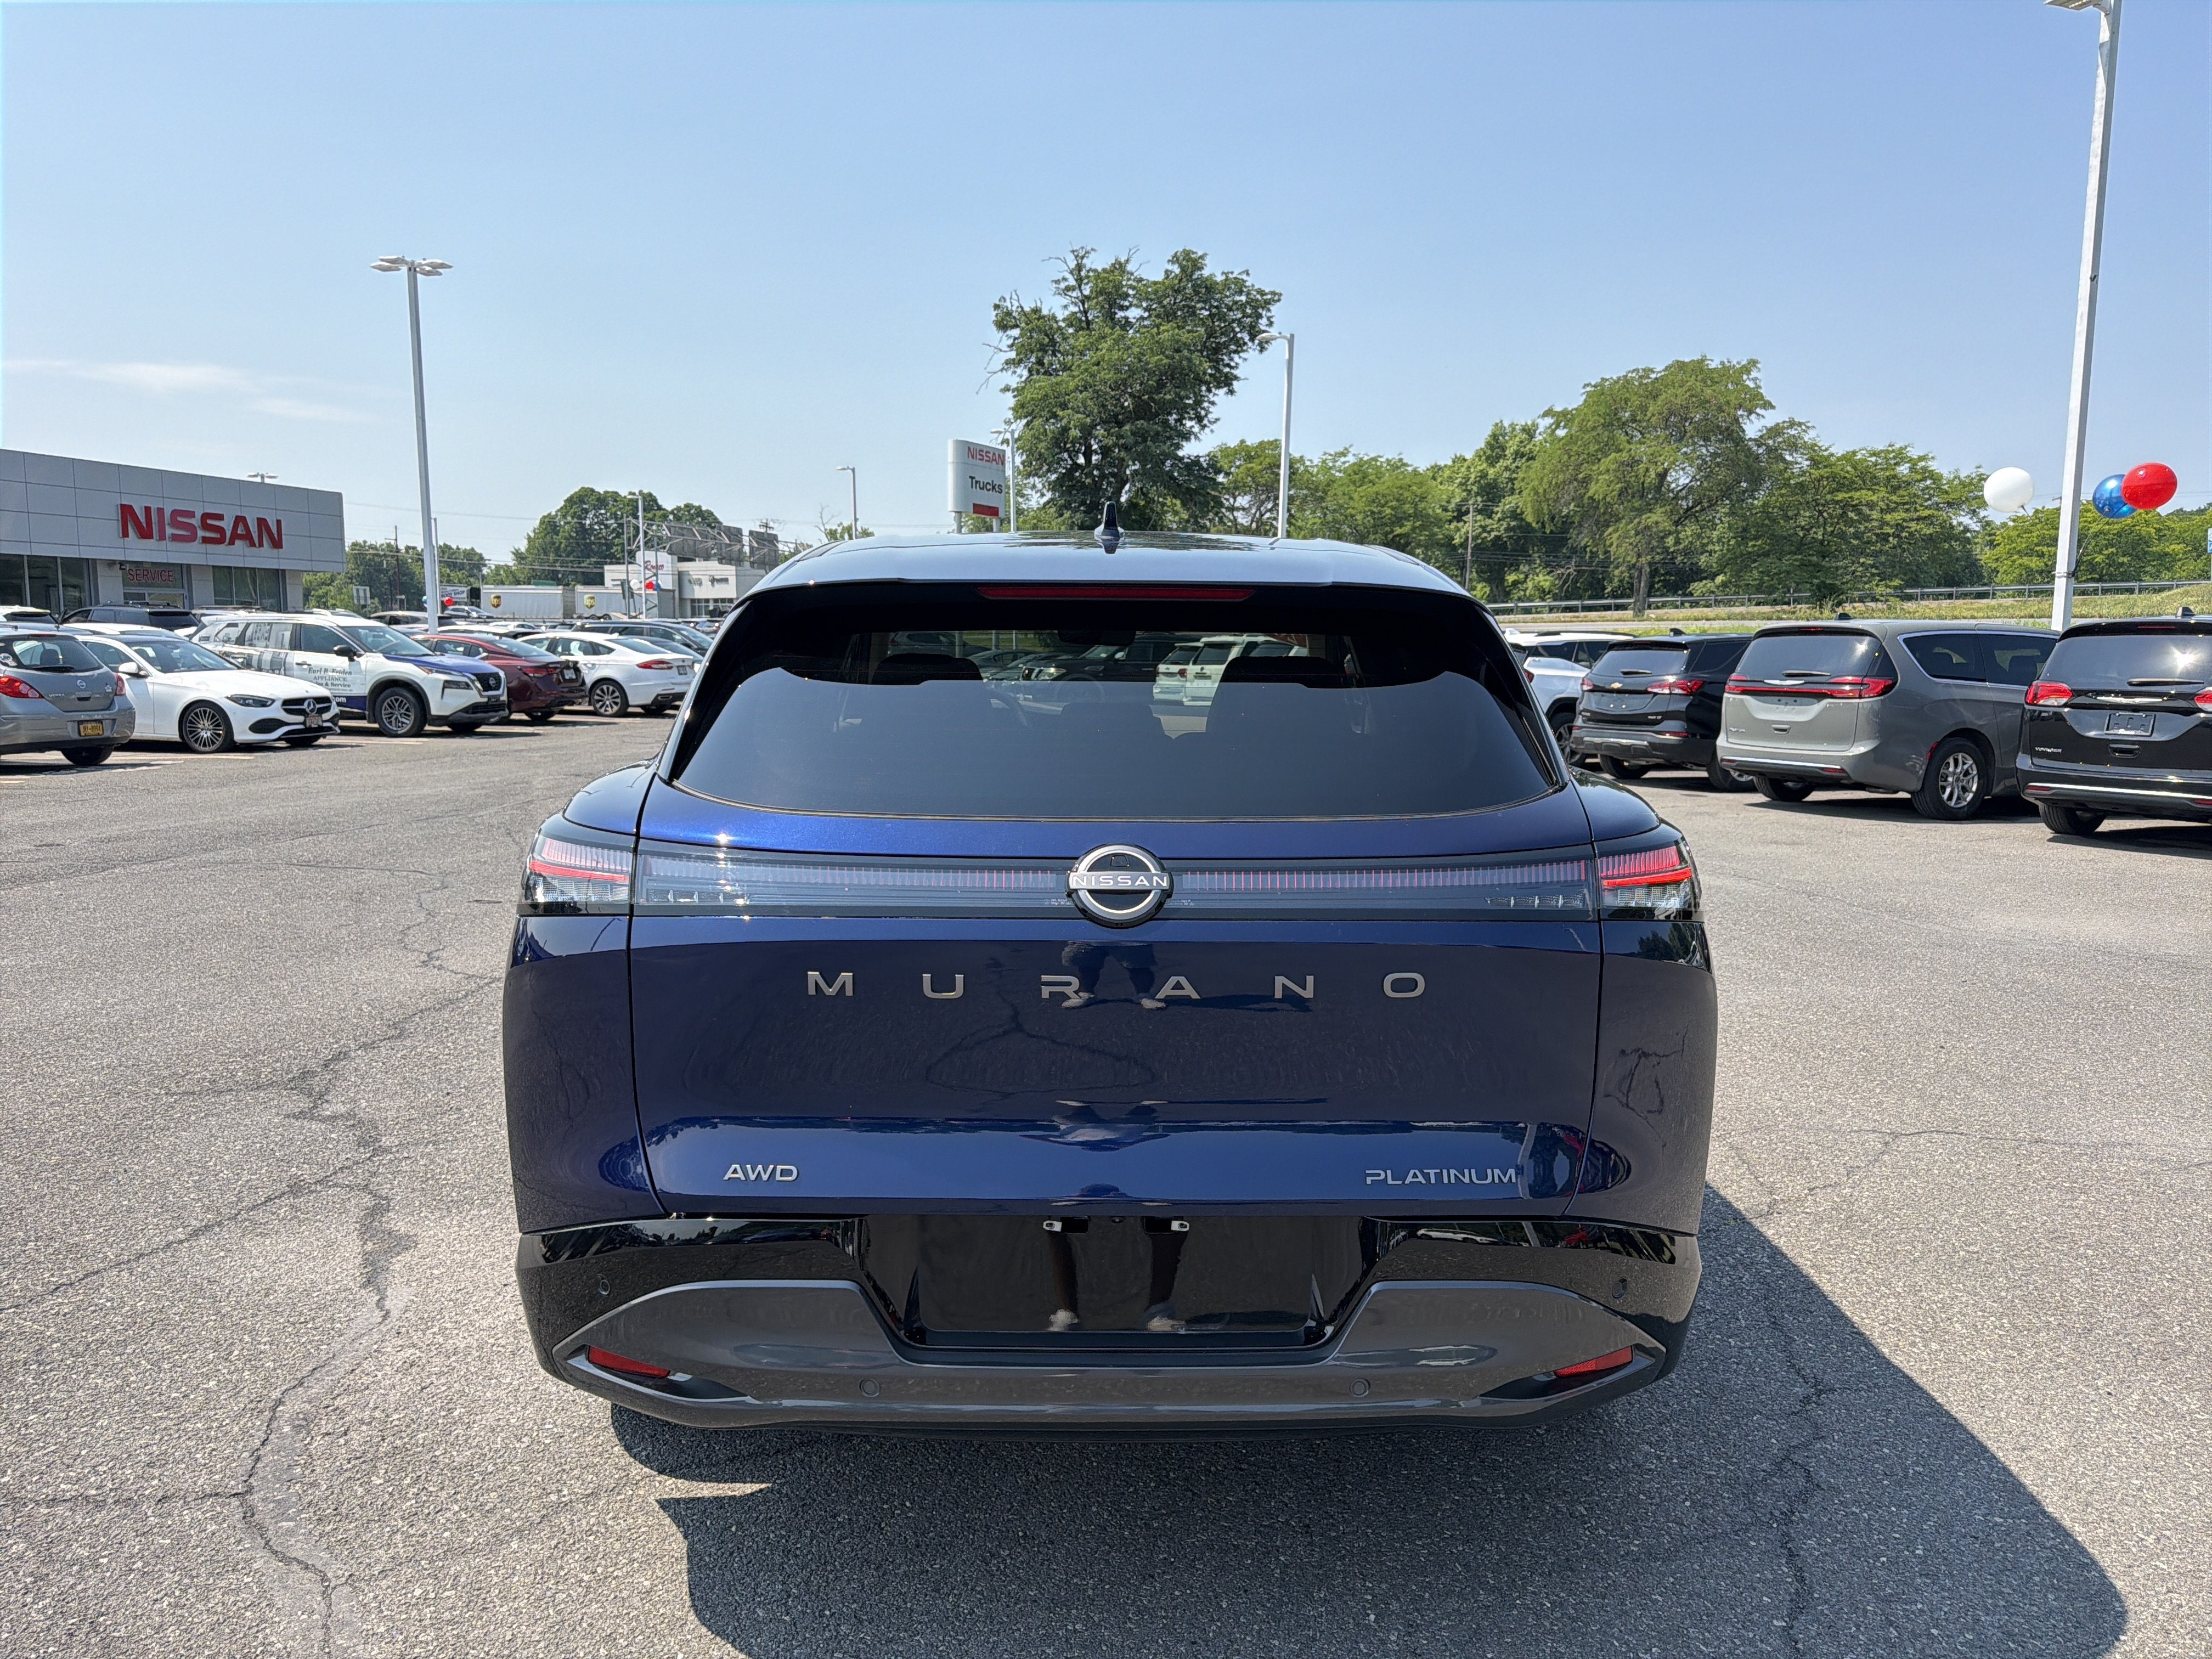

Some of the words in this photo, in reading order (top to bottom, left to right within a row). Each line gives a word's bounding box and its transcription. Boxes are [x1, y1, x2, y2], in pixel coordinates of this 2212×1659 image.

[967, 447, 1004, 466] NISSAN
[969, 476, 1003, 494] Trucks
[119, 503, 284, 549] NISSAN
[127, 568, 174, 583] SERVICE
[1073, 876, 1167, 887] NISSAN
[806, 971, 1426, 999] MURANO
[723, 1164, 799, 1181] AWD
[1365, 1169, 1516, 1185] PLATINUM
